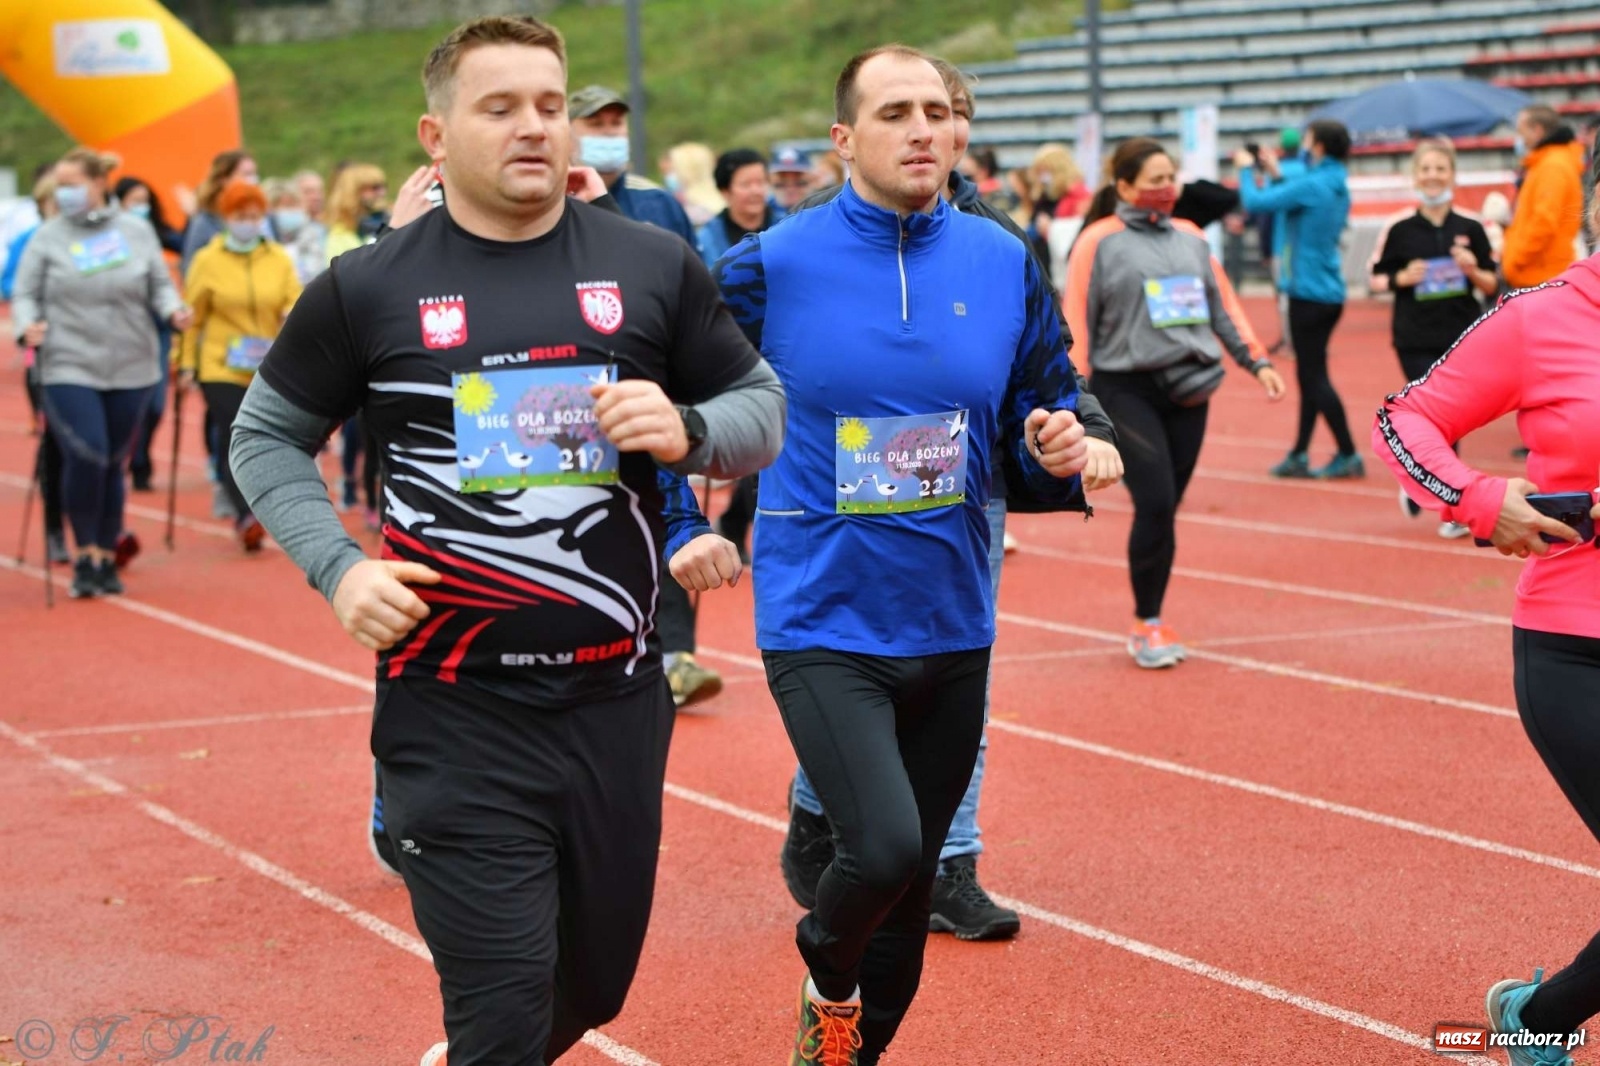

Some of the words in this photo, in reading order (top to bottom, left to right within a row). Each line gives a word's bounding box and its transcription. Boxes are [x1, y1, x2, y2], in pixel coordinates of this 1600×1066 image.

[418, 294, 465, 306] POLSKA
[476, 413, 510, 430] BIEG
[517, 411, 546, 428] DLA
[557, 446, 605, 474] 219
[854, 451, 881, 464] BIEG
[887, 450, 910, 463] DLA
[916, 444, 961, 461] BOŻENY
[918, 475, 956, 498] 223
